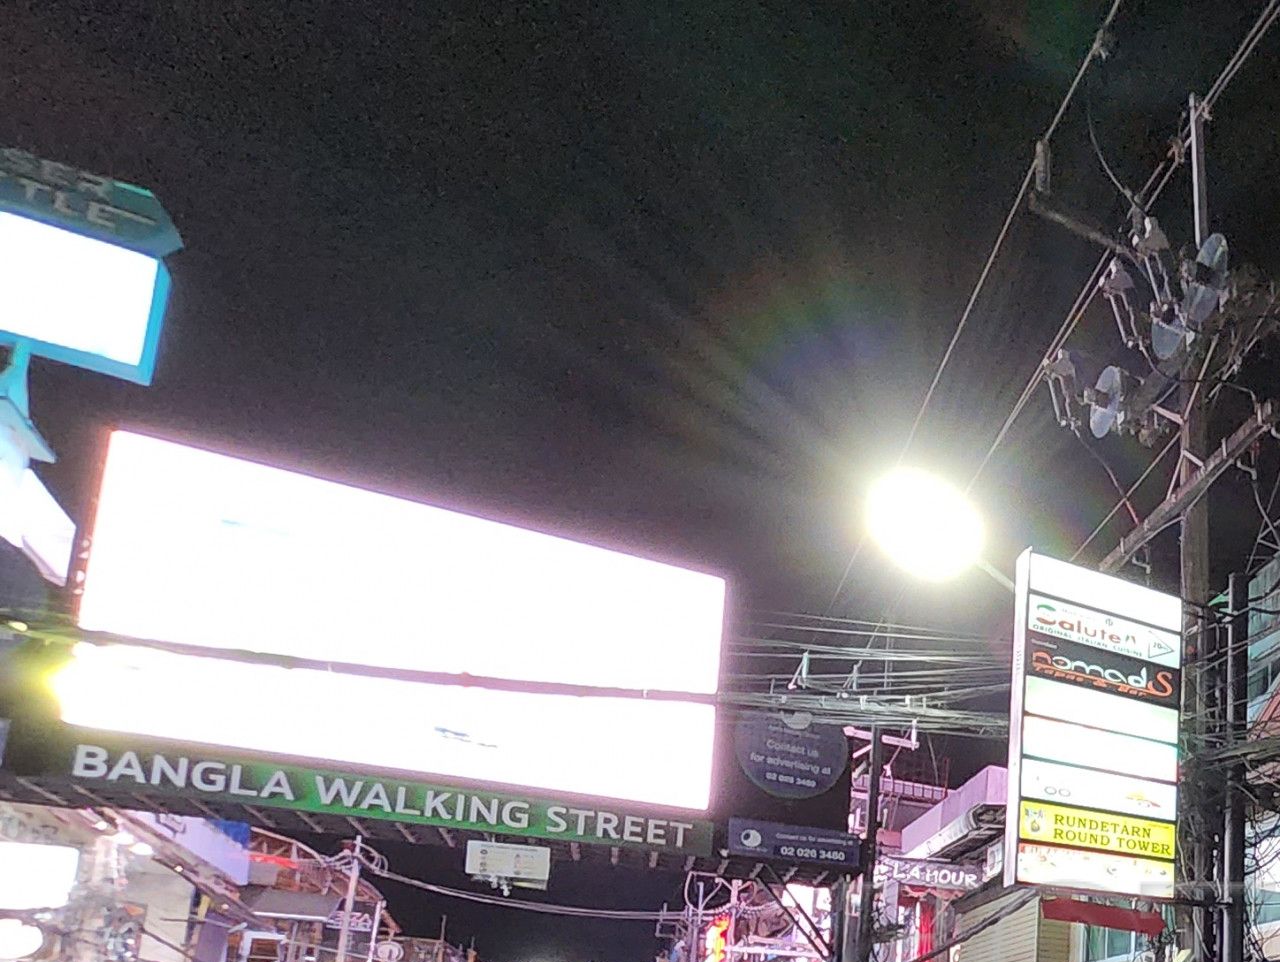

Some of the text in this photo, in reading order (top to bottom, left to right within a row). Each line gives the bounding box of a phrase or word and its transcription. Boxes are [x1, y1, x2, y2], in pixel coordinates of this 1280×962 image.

[1032, 623, 1072, 638] ORIGINAL
[1078, 636, 1108, 648] ITALIAN
[766, 738, 805, 755] Contact
[750, 752, 765, 763] for
[72, 744, 694, 848] BANGLA WALKING STREET
[780, 846, 795, 856] 02
[1053, 828, 1172, 856] ROUND TOWER
